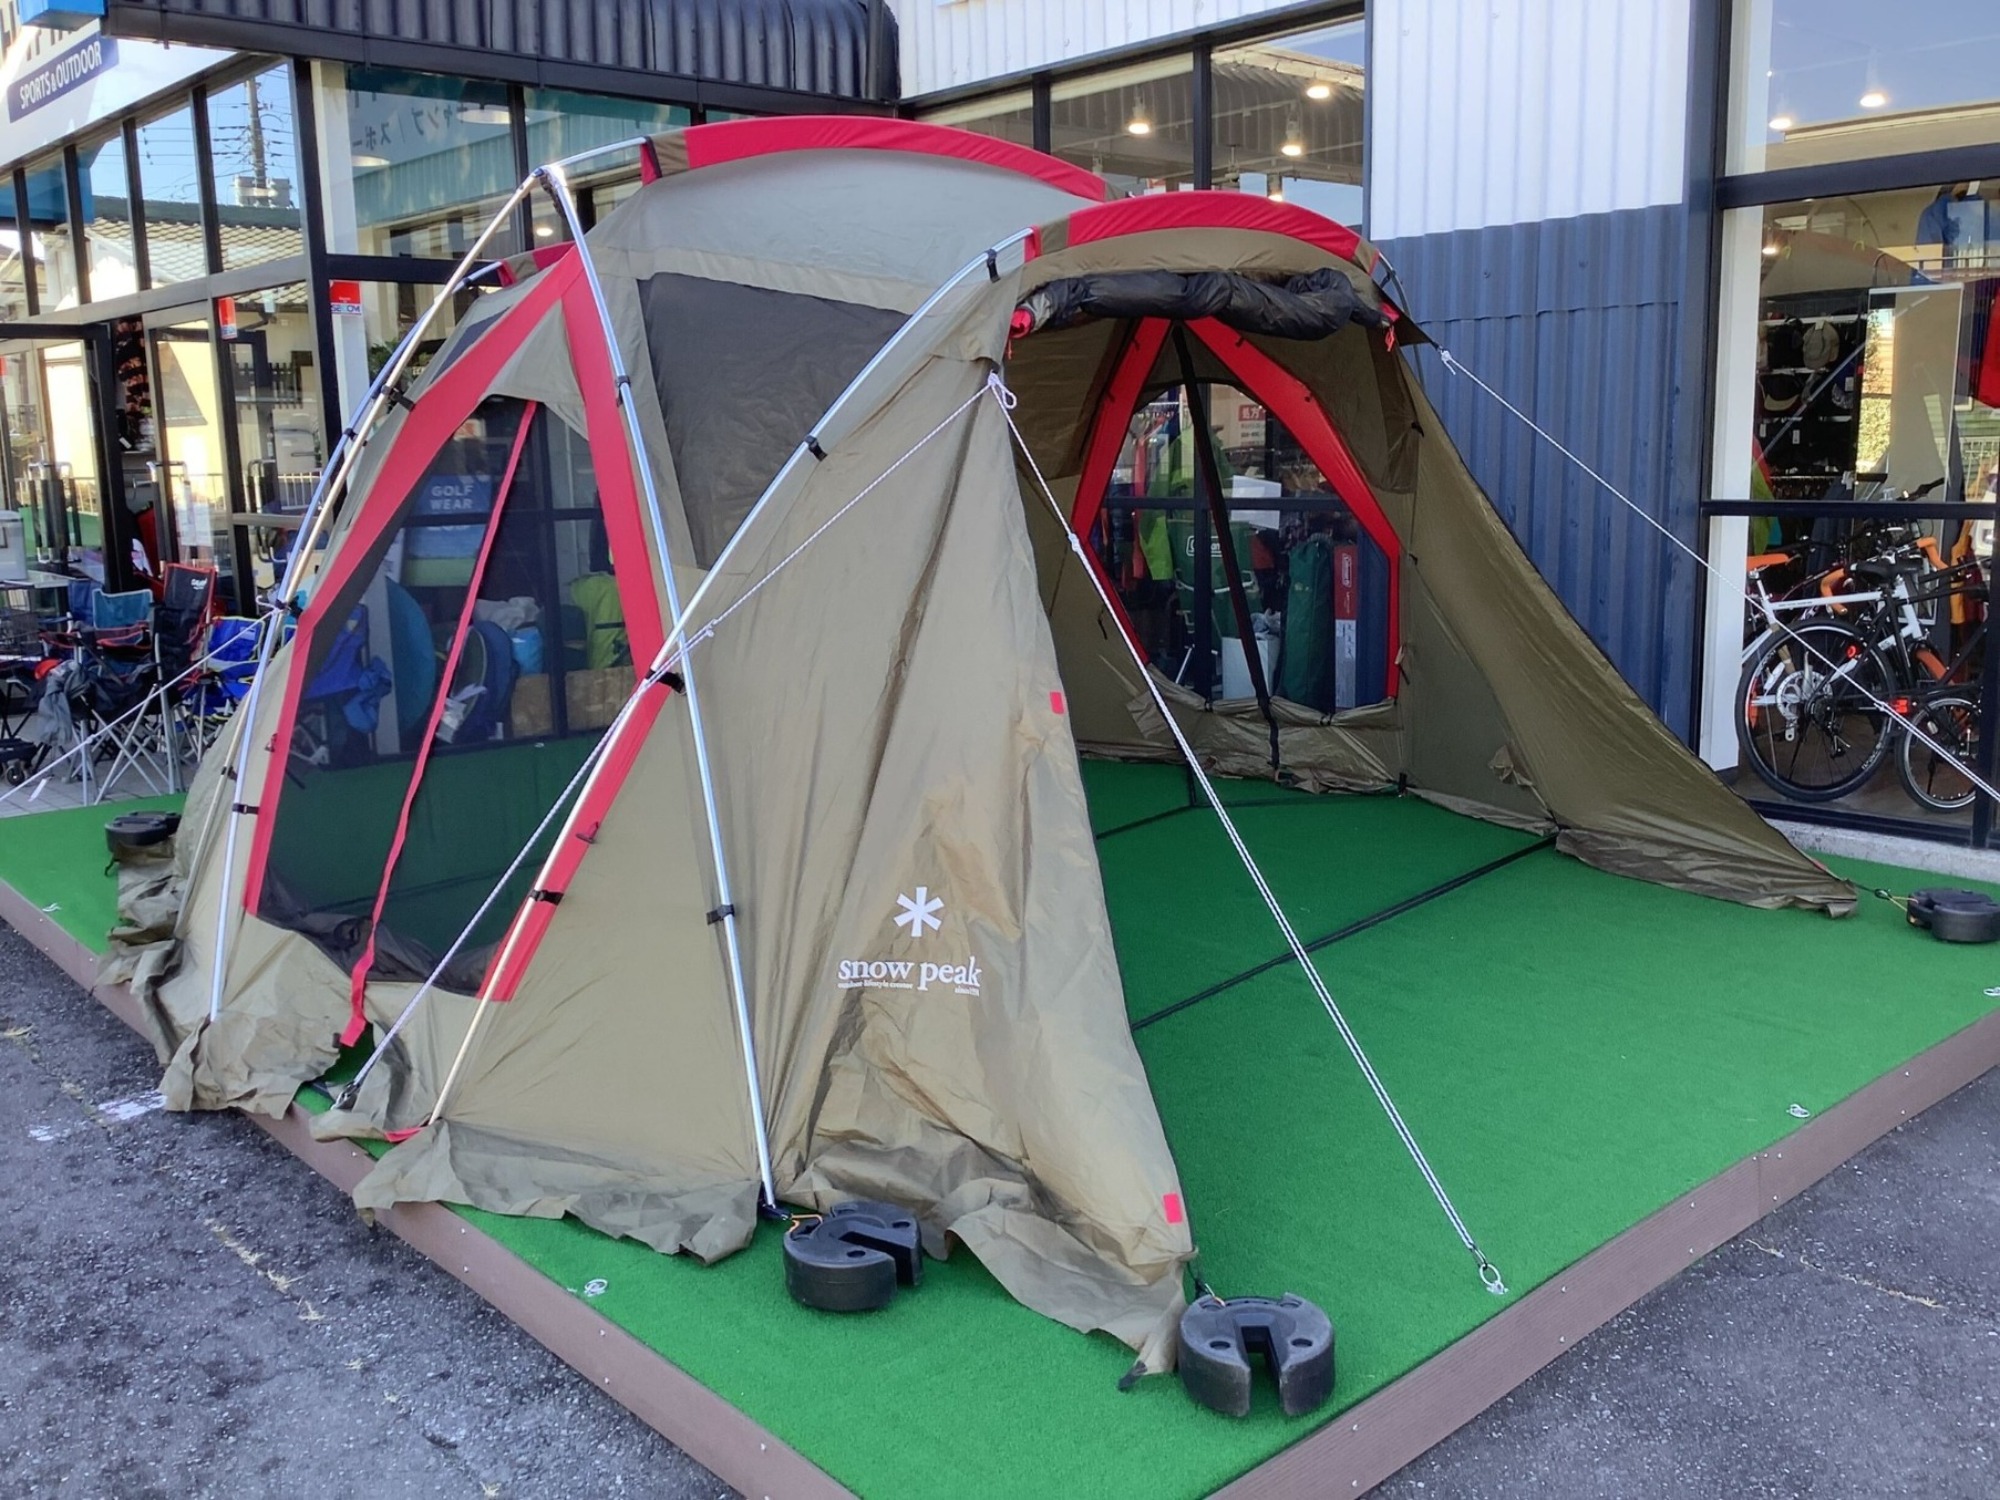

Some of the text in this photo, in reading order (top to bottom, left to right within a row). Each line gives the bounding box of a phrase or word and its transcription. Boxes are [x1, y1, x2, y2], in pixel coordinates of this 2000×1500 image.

[20, 71, 51, 110] SPORTS
[55, 41, 102, 88] OUTDOOR
[331, 304, 361, 313] SEOM
[431, 485, 474, 496] GOLF
[430, 499, 473, 510] WEAR
[838, 955, 982, 991] snow peak
